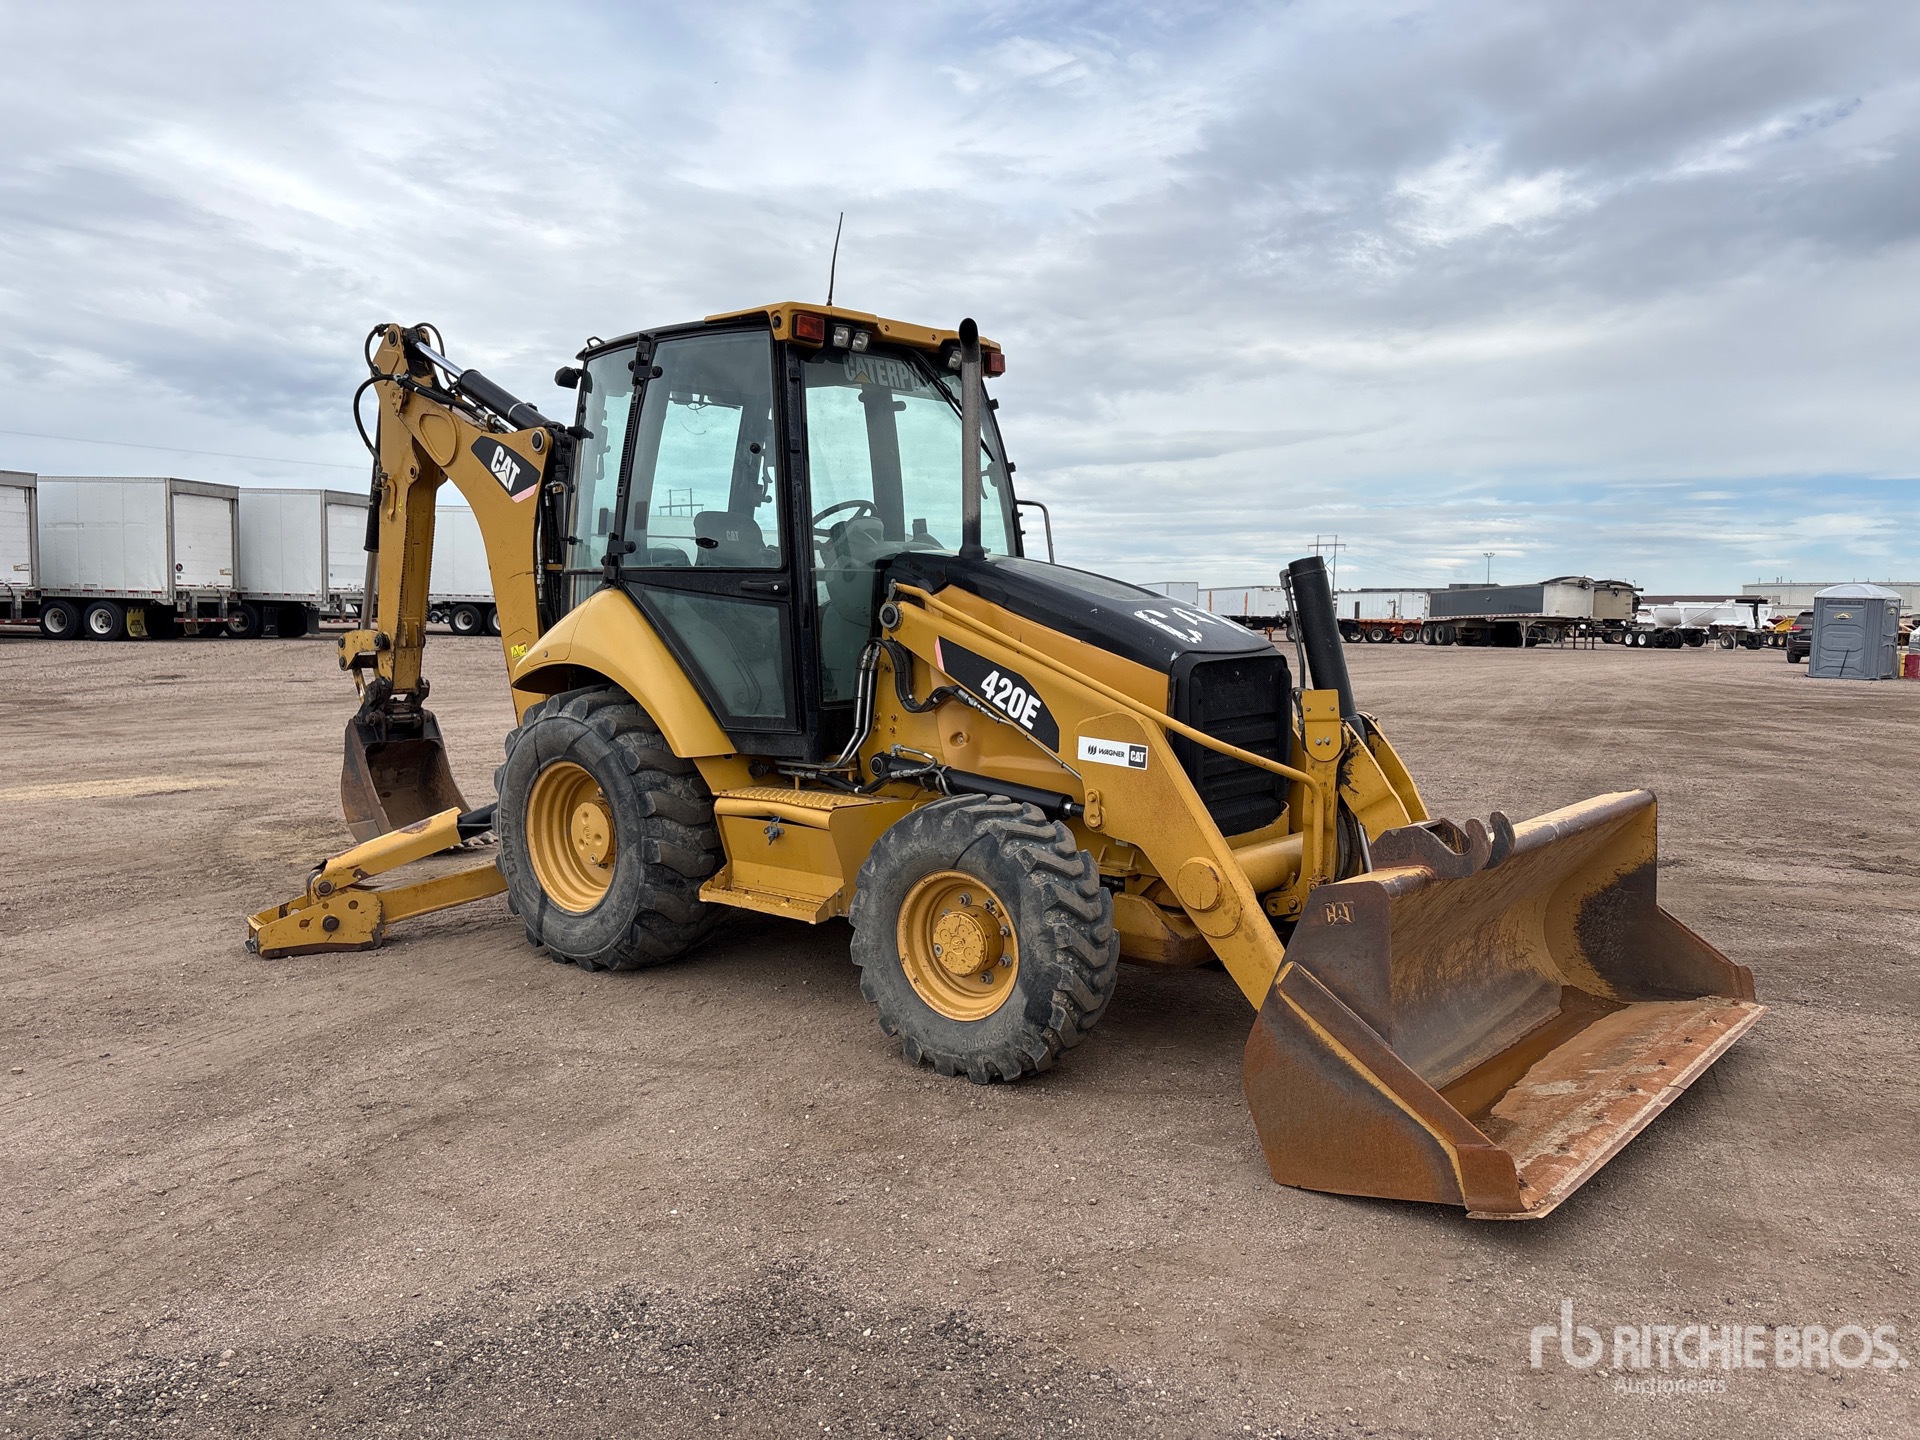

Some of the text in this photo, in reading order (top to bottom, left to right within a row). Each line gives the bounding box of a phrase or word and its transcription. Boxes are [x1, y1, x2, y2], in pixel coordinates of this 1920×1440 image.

[490, 446, 521, 491] CAT
[726, 530, 739, 542] CAT
[980, 670, 1042, 730] 420E
[1098, 748, 1125, 759] WAGNER
[1129, 750, 1146, 763] CAT
